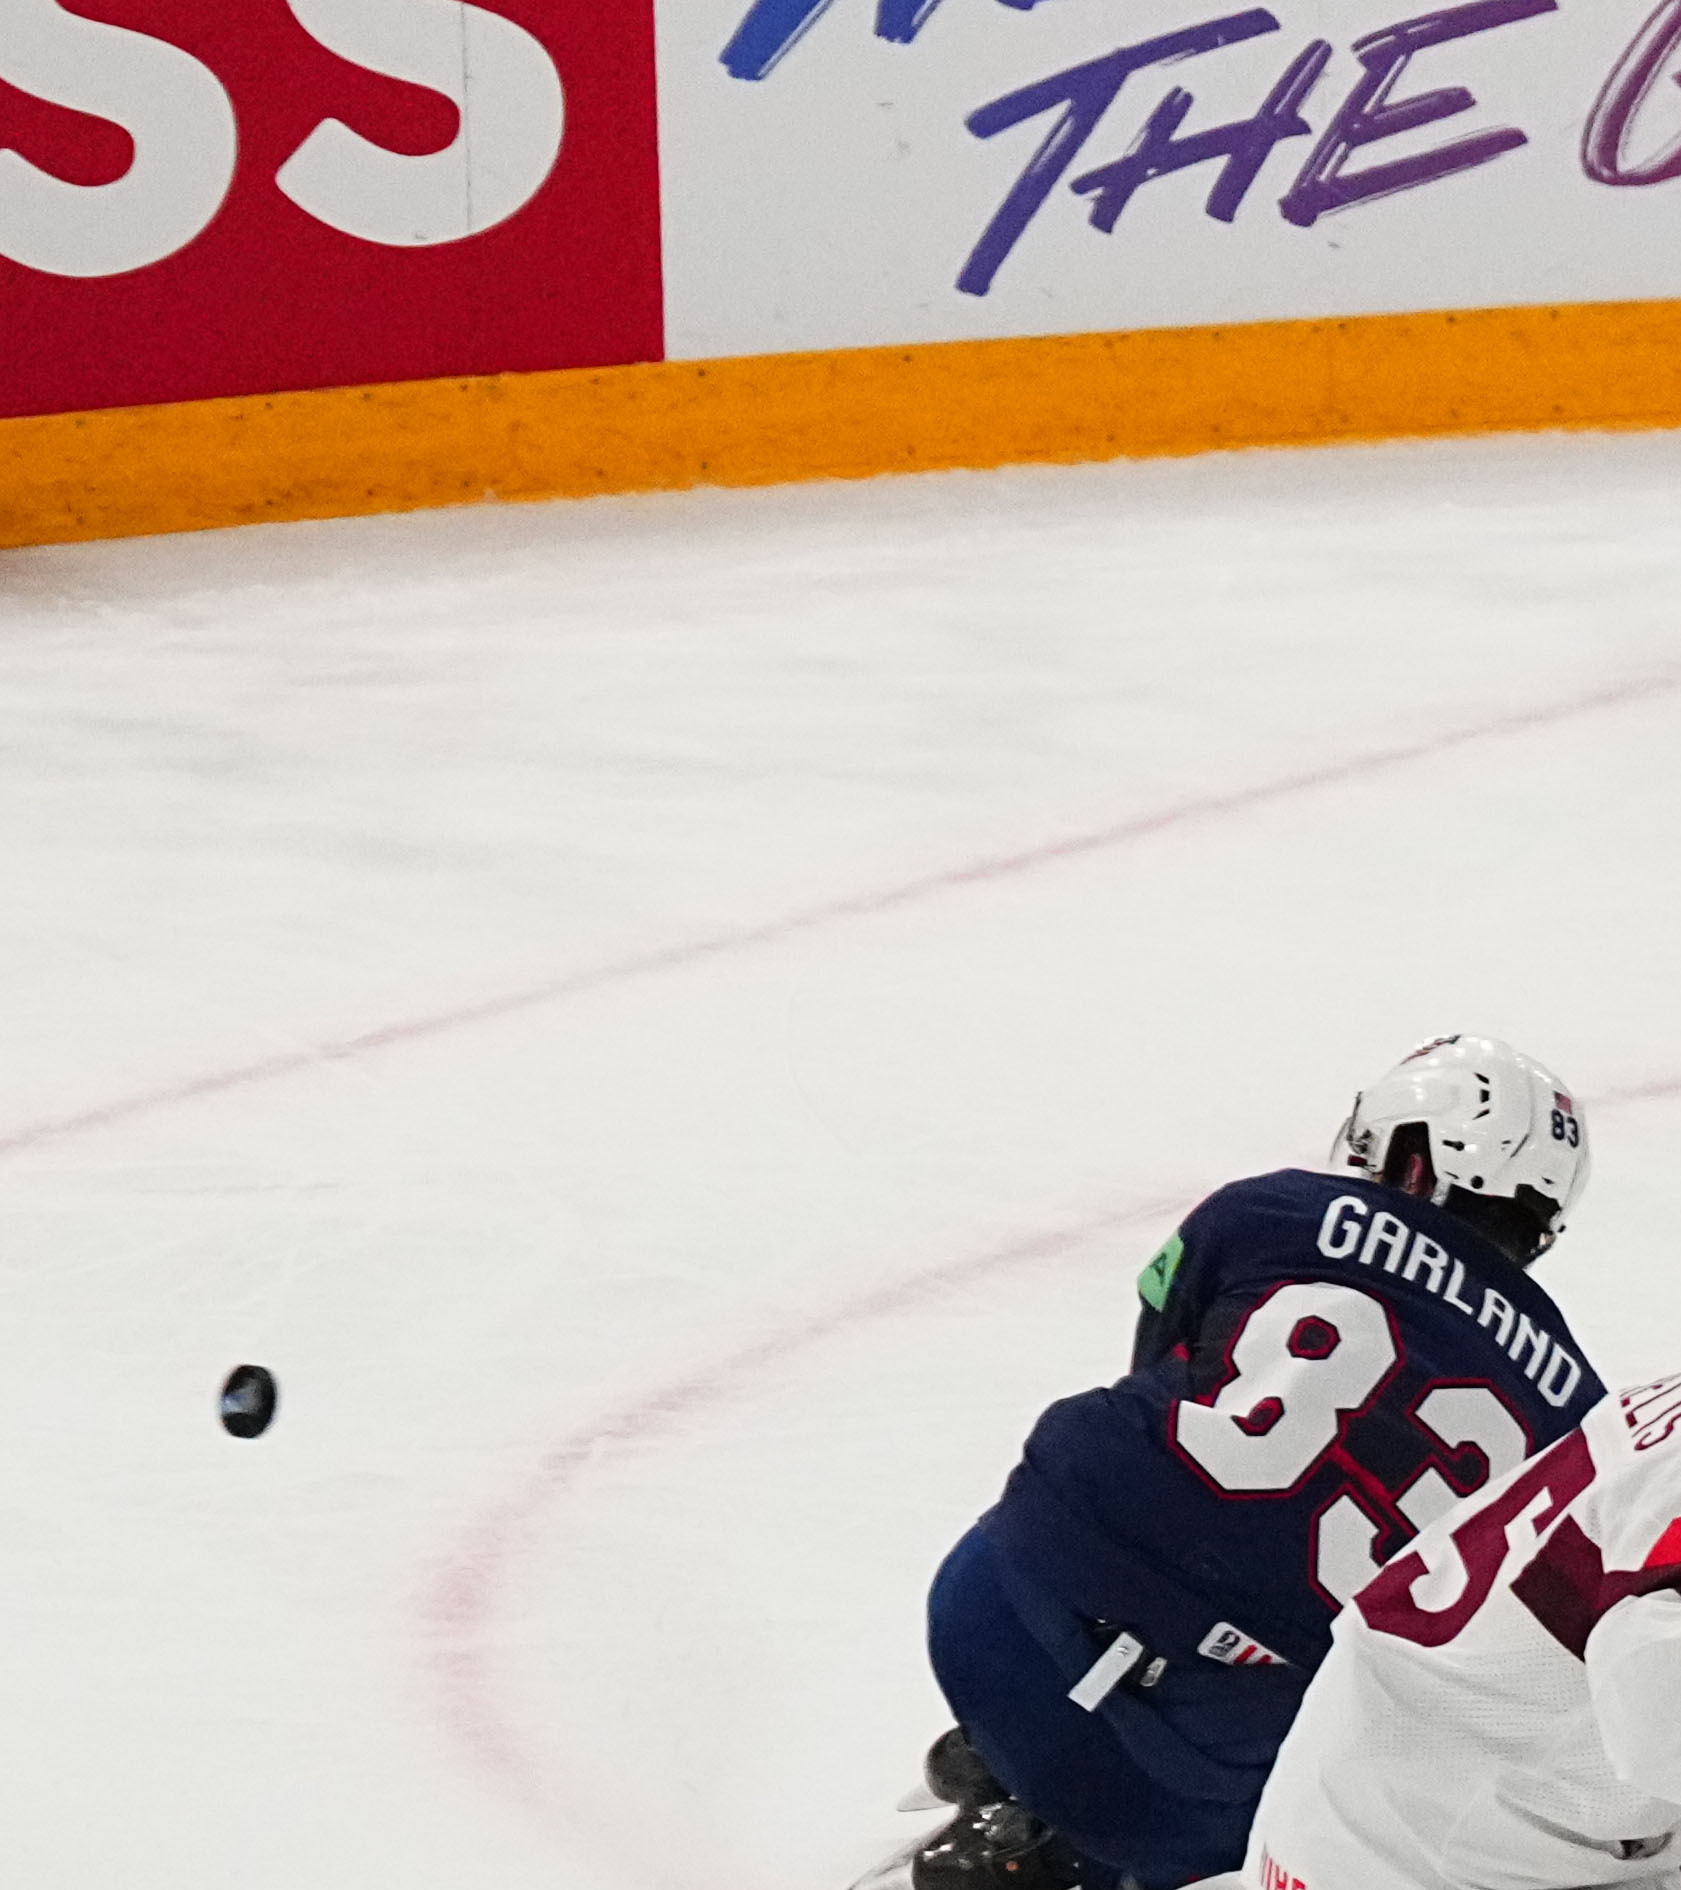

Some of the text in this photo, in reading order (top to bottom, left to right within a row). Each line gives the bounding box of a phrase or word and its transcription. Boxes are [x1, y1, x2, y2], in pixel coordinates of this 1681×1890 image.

[954, 0, 1559, 298] THE
[1550, 1109, 1580, 1149] 83
[1315, 1194, 1562, 1408] GARLAND
[1166, 1279, 1535, 1614] 83
[1352, 1427, 1598, 1649] 5
